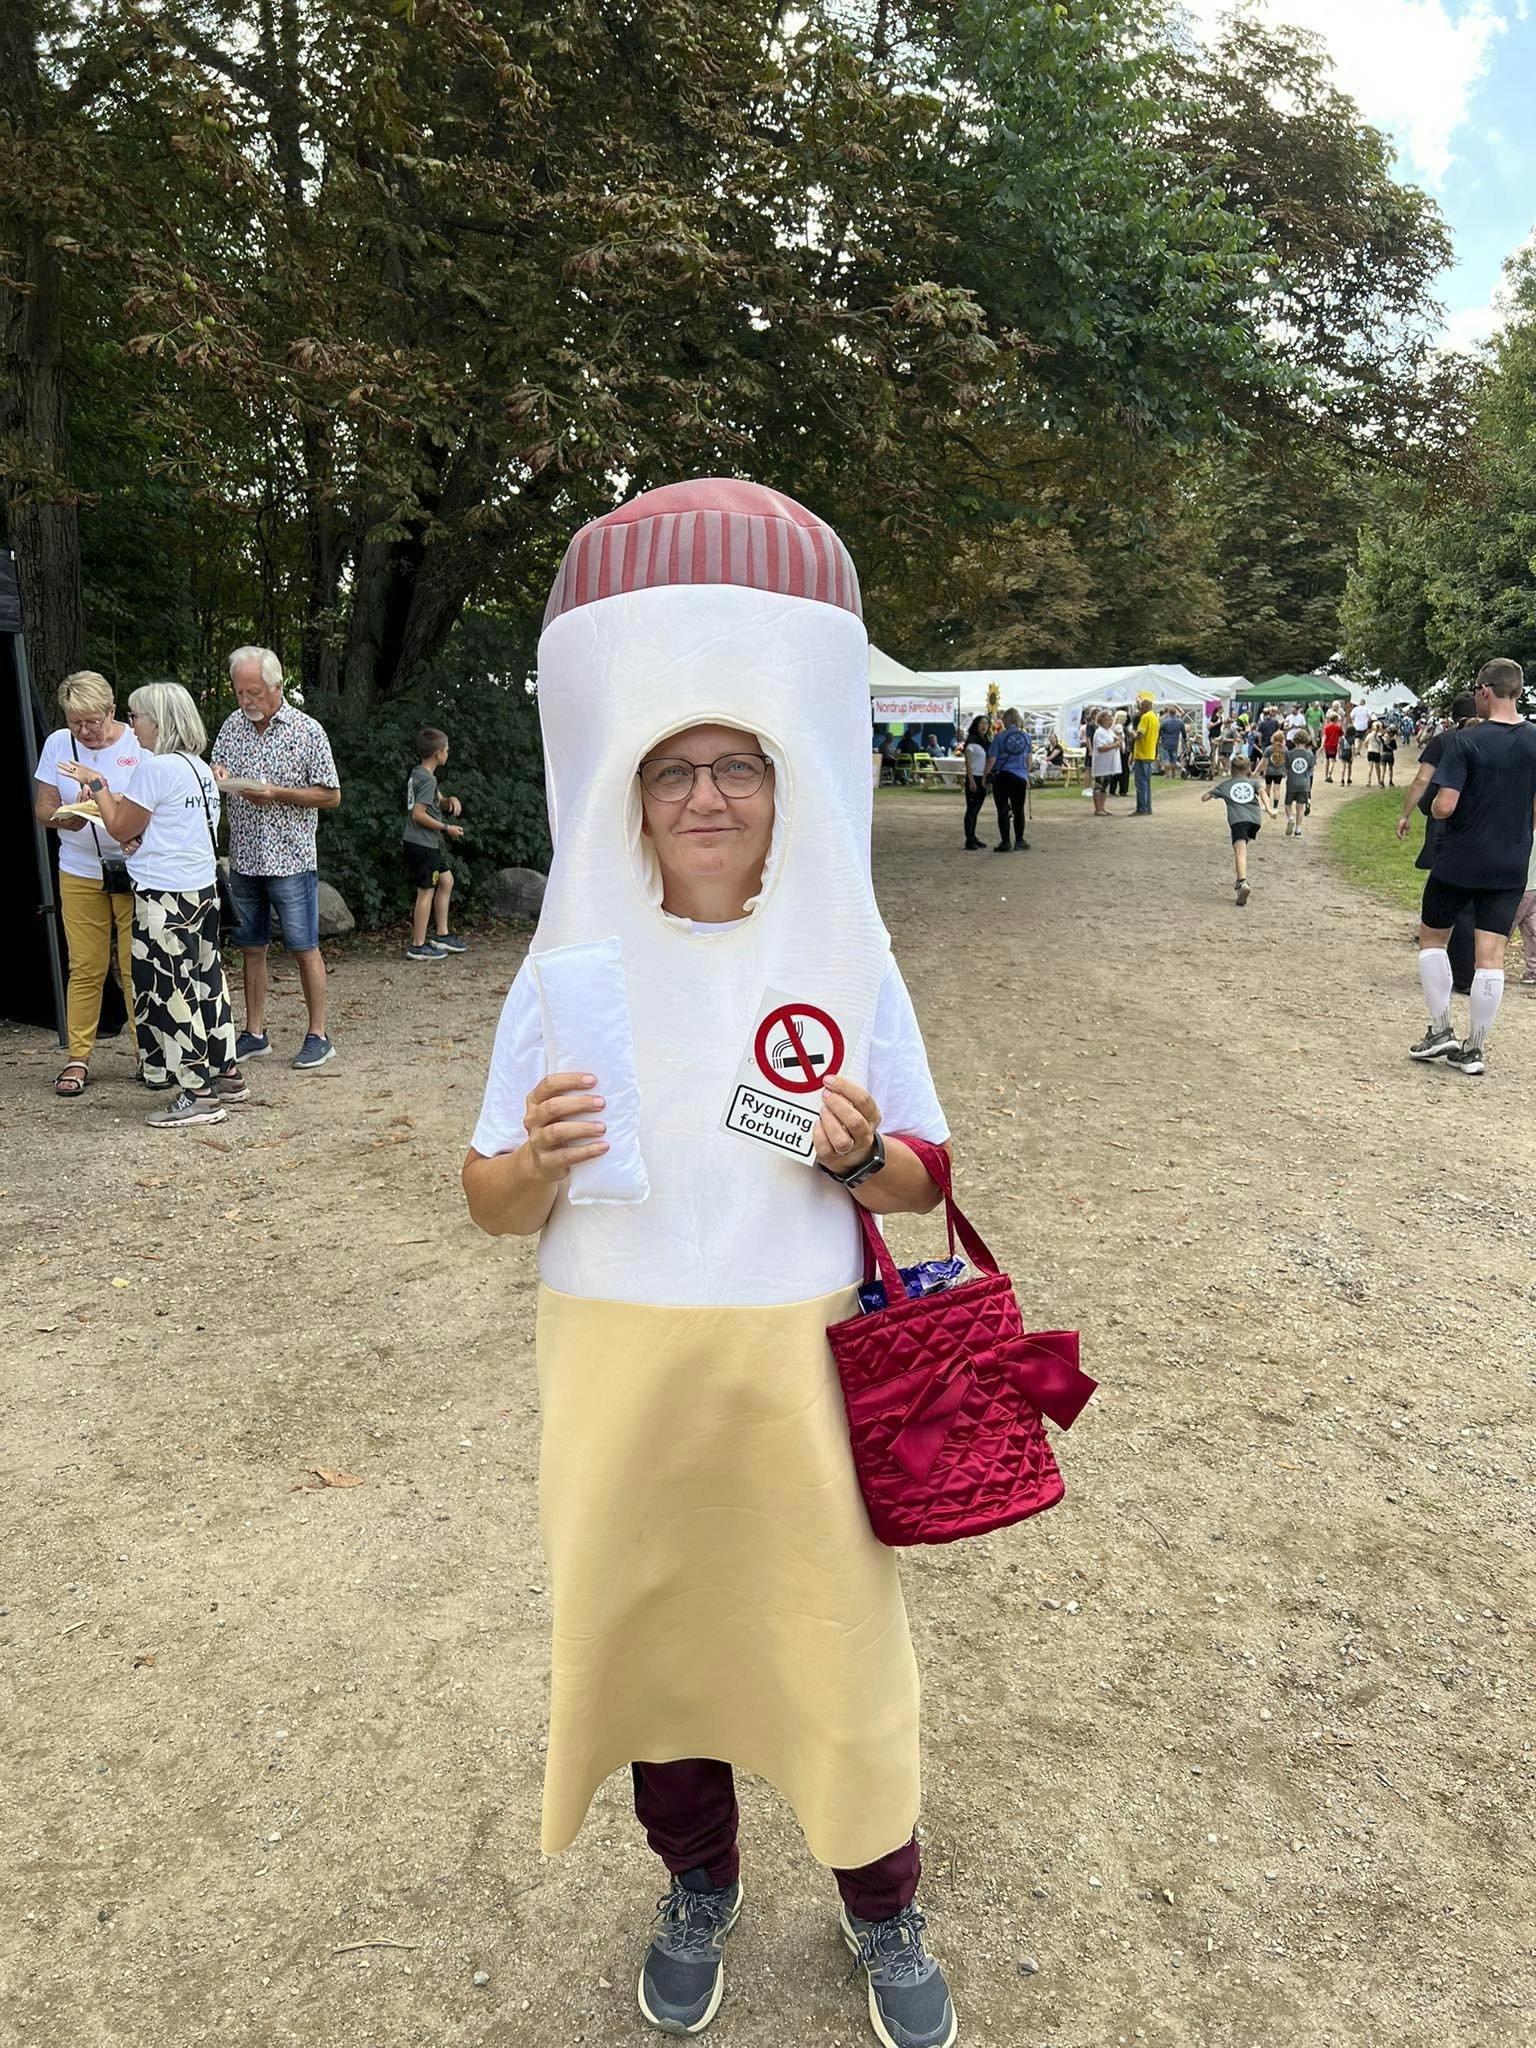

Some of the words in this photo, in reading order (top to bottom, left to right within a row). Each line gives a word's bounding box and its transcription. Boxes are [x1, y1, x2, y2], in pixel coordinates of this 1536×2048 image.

[876, 702, 907, 714] Nordrup
[740, 1113, 803, 1148] forbudt
[742, 1093, 813, 1133] Rygning
